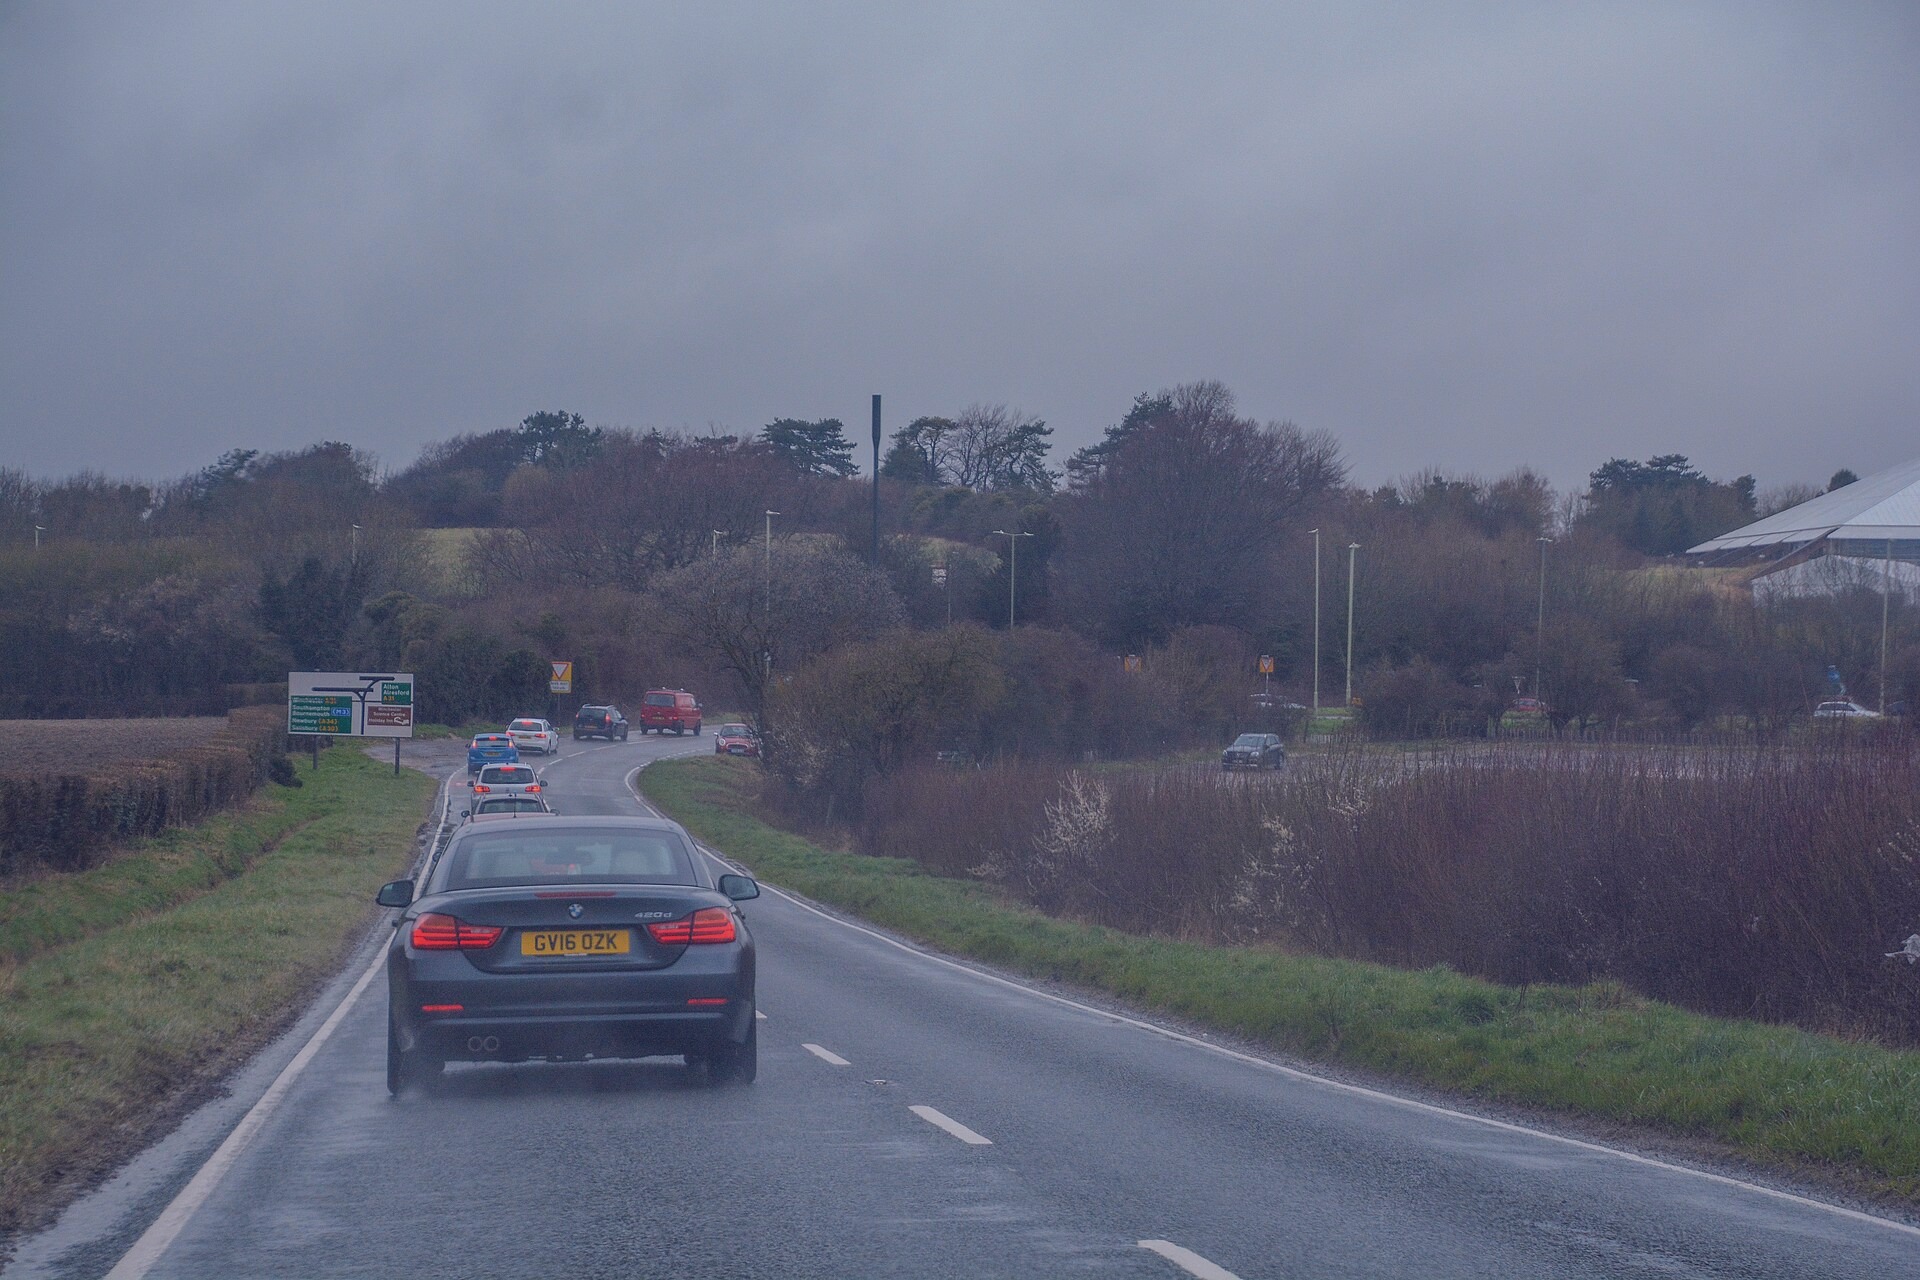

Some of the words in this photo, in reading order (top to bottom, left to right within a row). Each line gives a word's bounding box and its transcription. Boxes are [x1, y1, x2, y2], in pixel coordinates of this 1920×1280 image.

[634, 910, 673, 919] 420d
[534, 934, 576, 952] GV16
[582, 932, 618, 951] OZK
